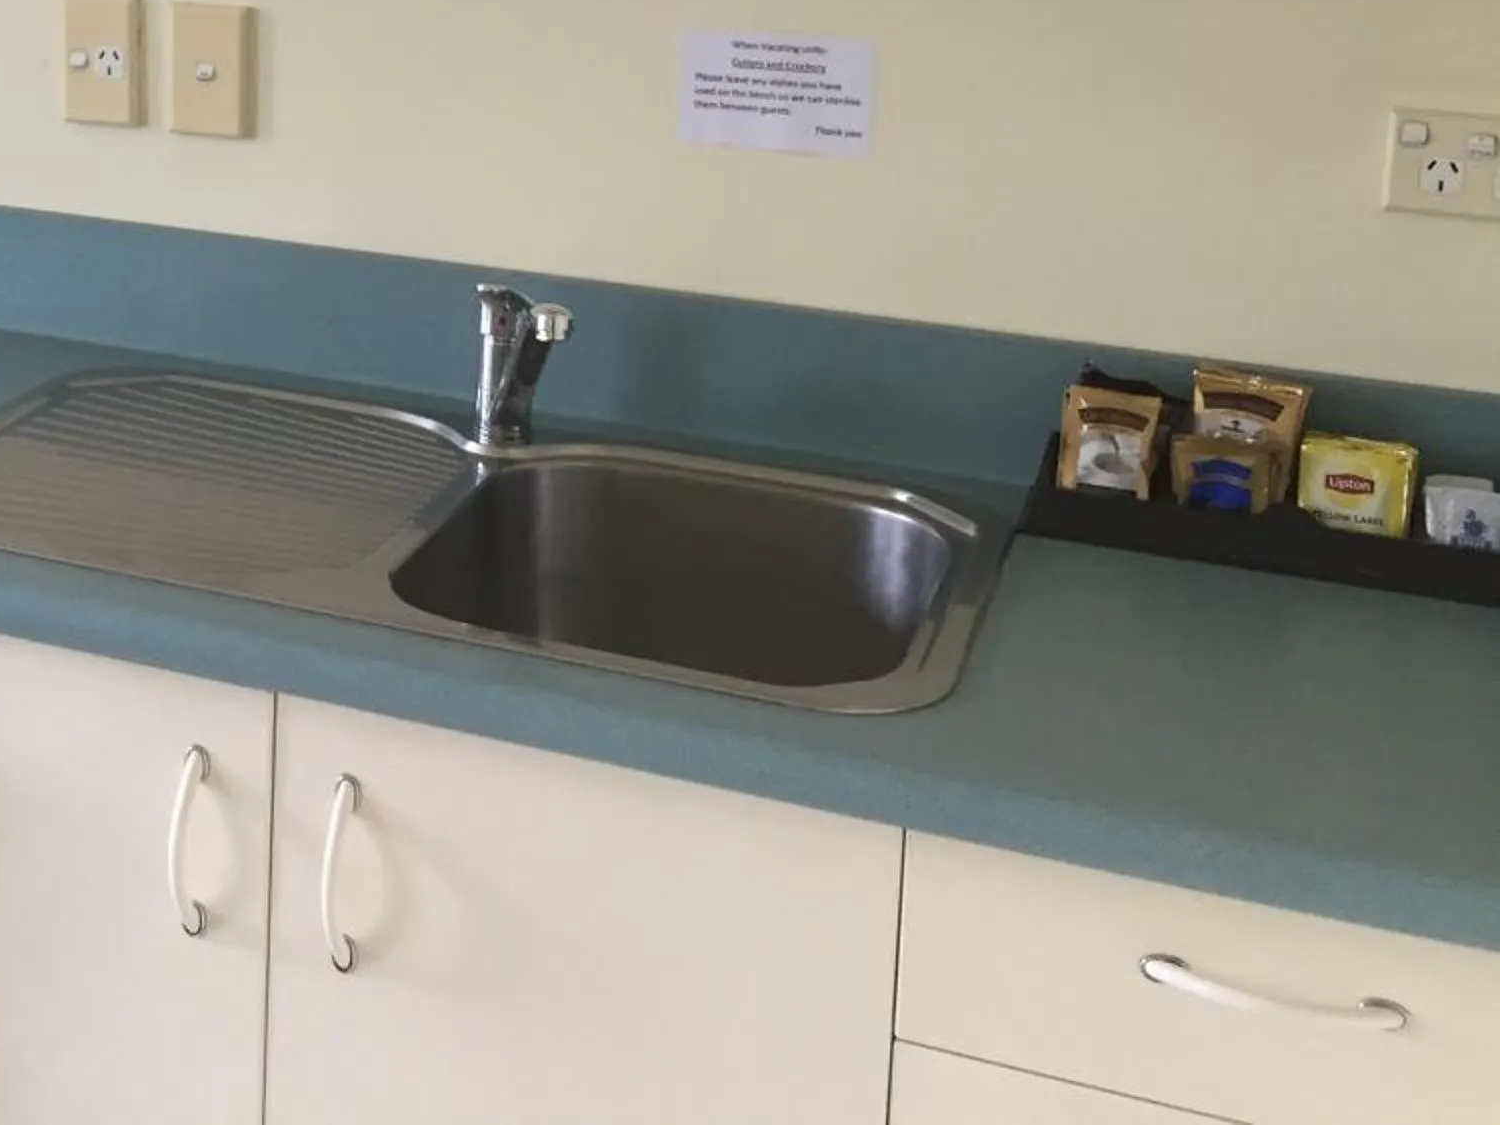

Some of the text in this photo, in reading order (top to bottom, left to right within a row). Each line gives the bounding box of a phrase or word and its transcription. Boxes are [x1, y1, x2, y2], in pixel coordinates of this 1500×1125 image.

[732, 39, 759, 49] When
[695, 72, 723, 82] Please
[819, 82, 842, 91] have
[1329, 475, 1372, 492] Lipton
